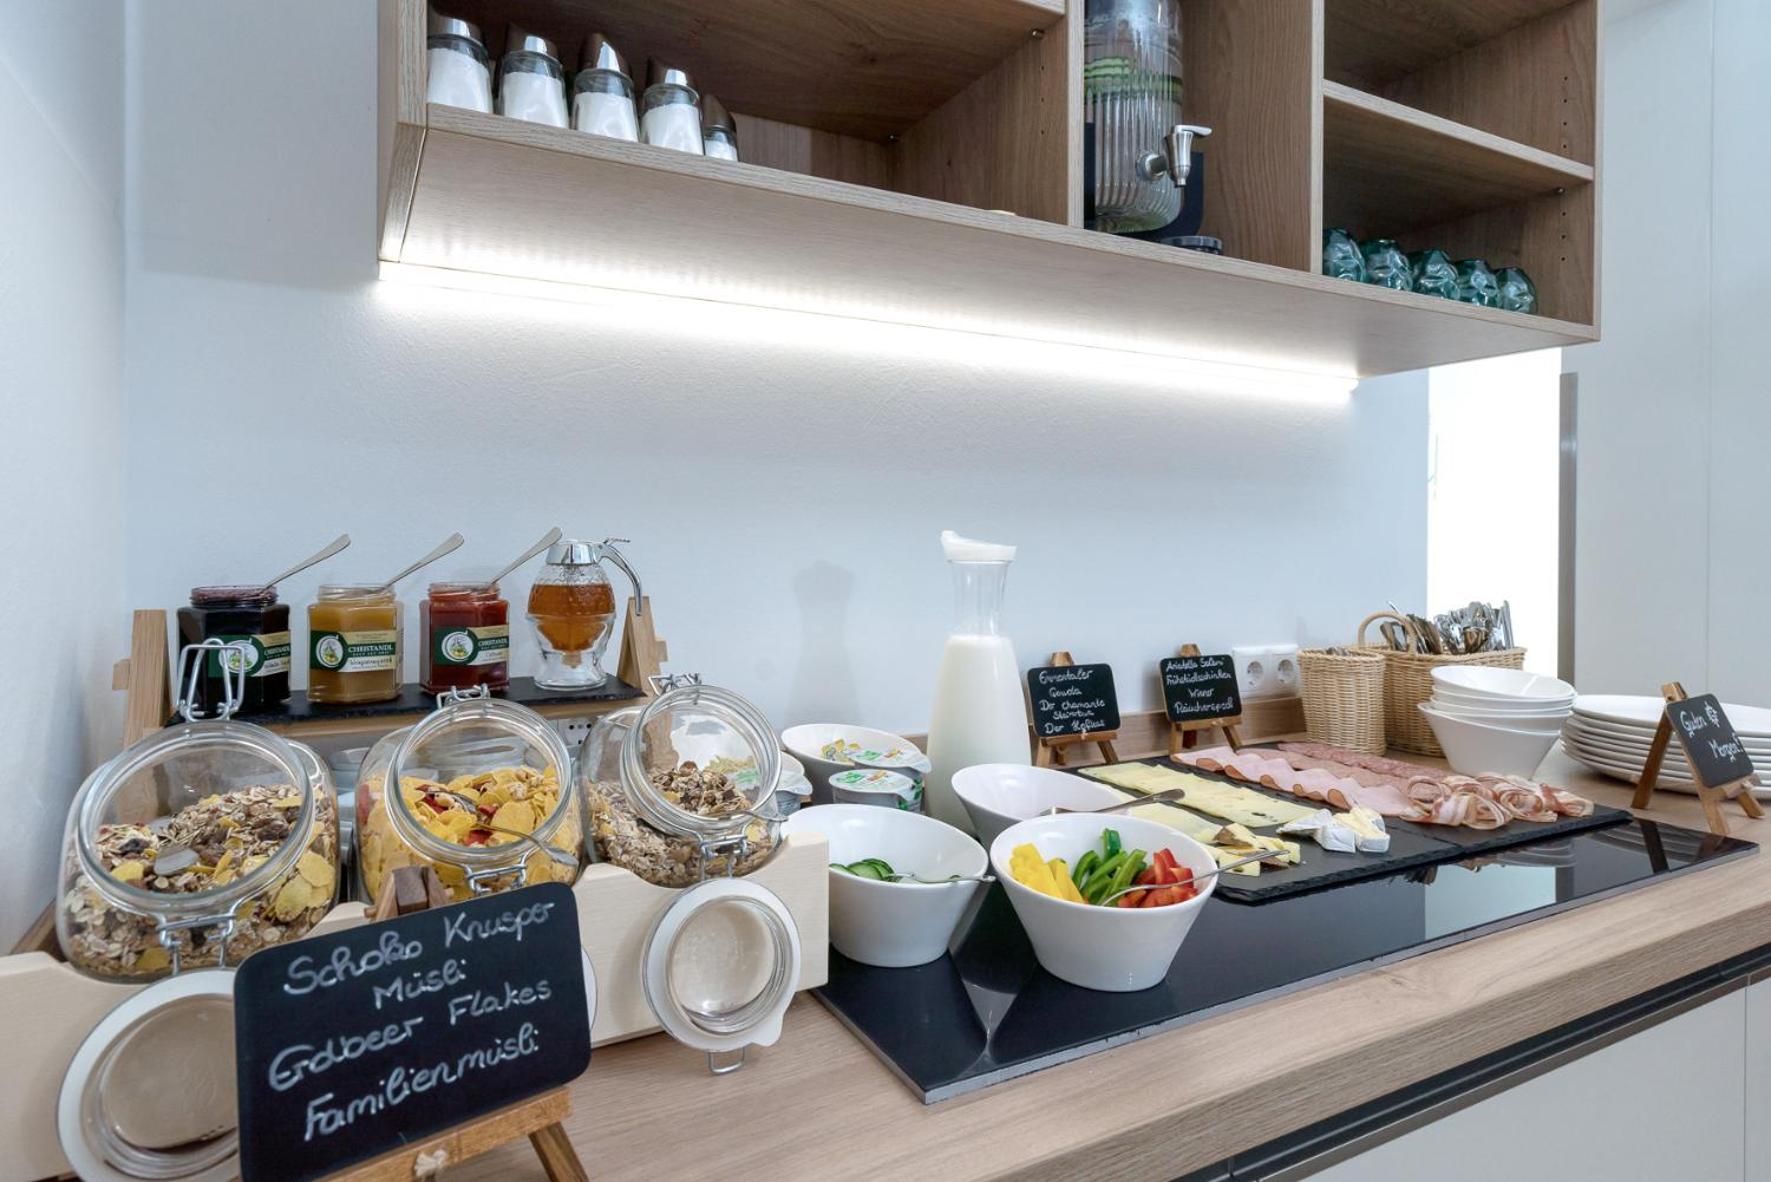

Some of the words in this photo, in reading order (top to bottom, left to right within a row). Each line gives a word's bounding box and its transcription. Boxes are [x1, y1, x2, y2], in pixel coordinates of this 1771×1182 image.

[1048, 685, 1082, 698] Gouda
[1044, 722, 1064, 734] Der
[1680, 711, 1708, 738] Guten
[283, 930, 423, 995] Schoko
[442, 902, 555, 948] Knusper
[372, 958, 468, 1009] Müsli
[268, 1016, 424, 1092] Erdbeer
[448, 979, 551, 1026] Flakes
